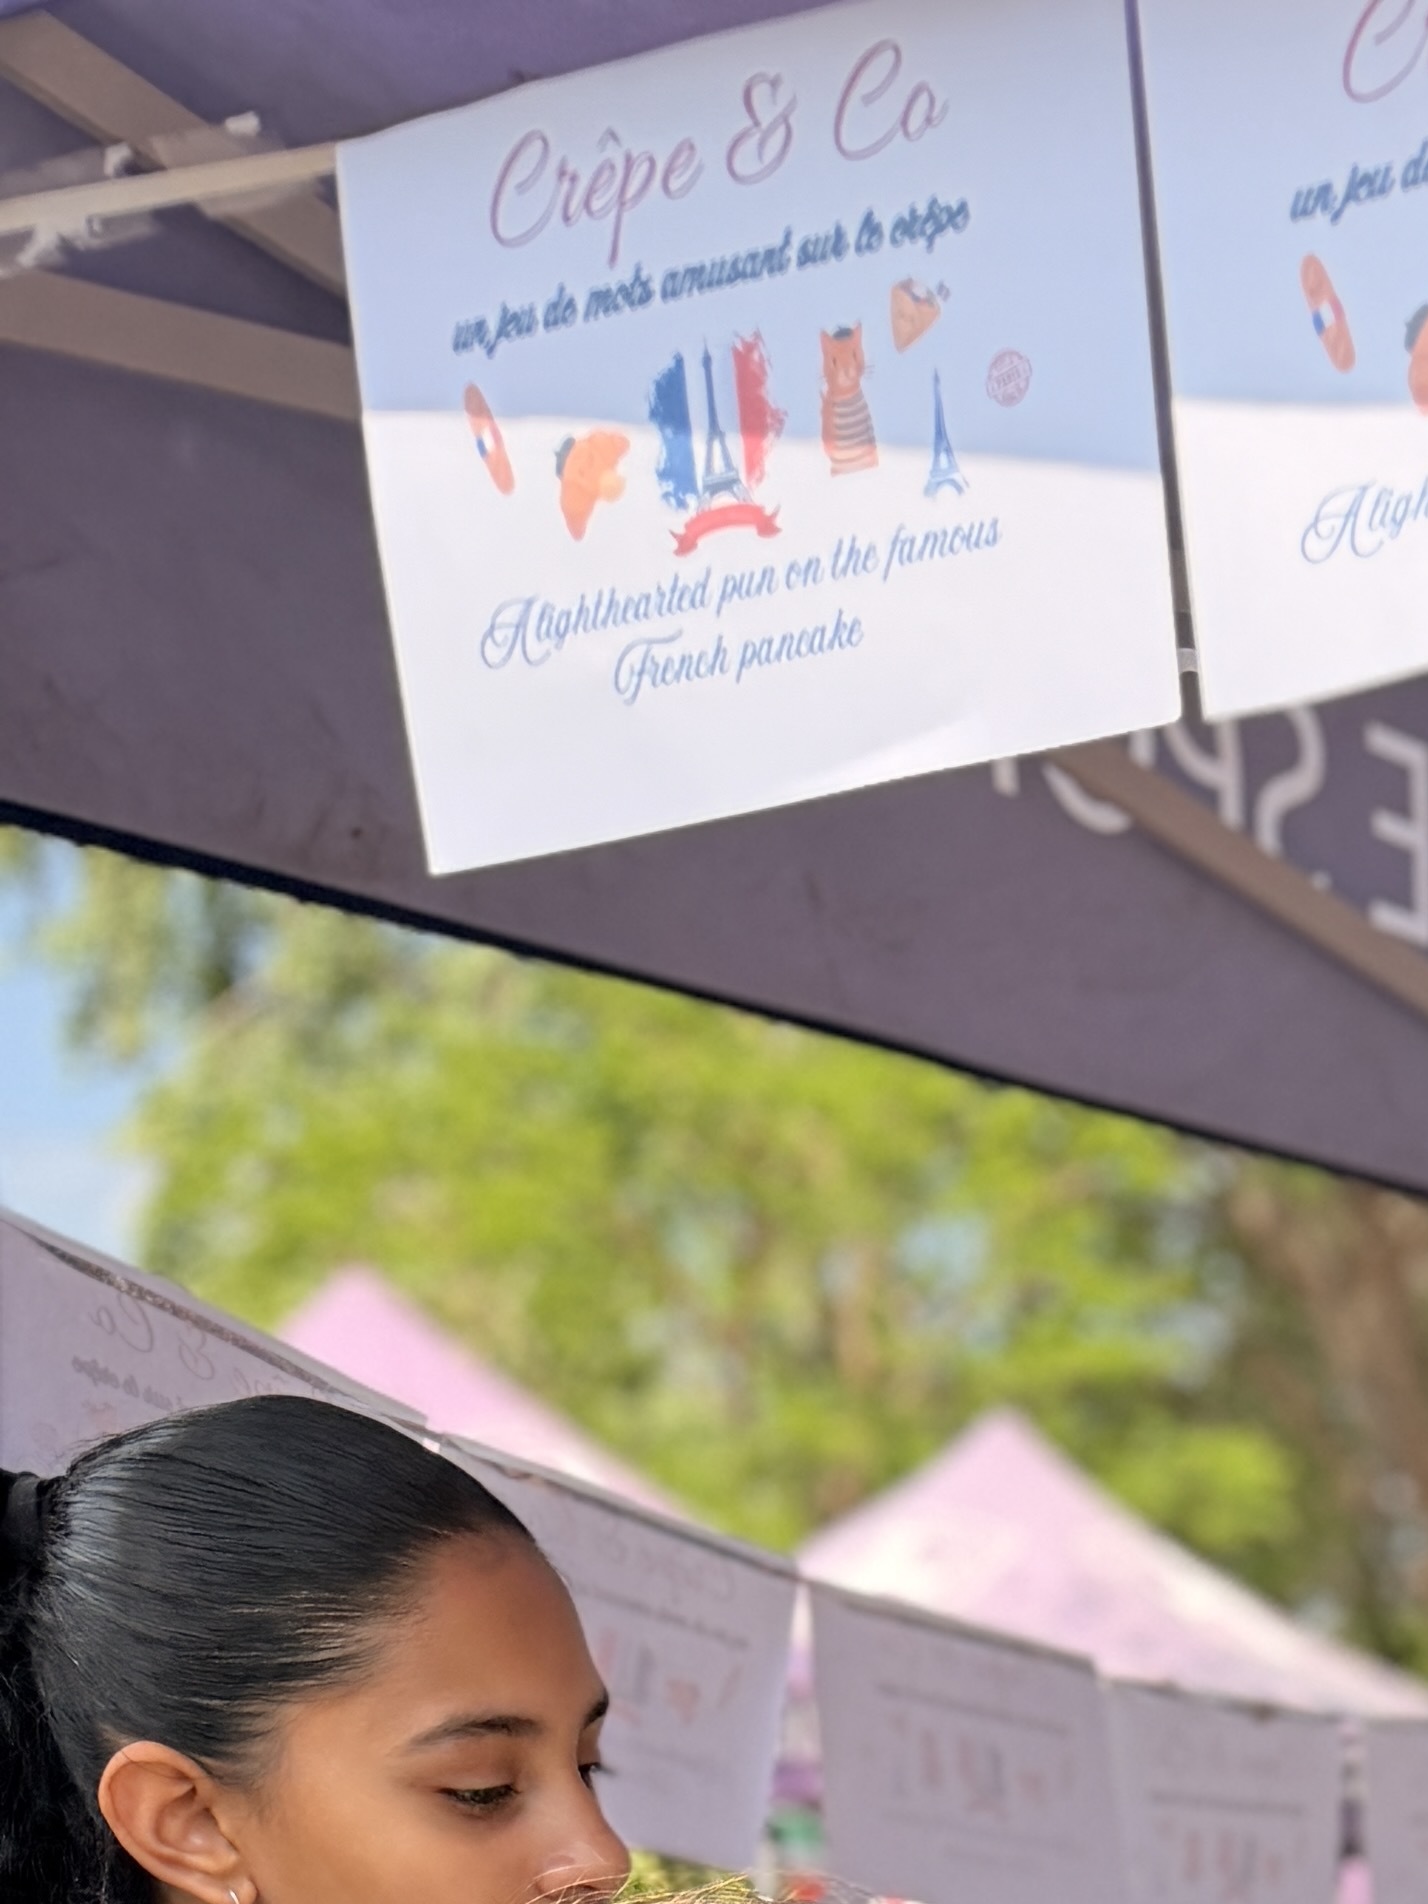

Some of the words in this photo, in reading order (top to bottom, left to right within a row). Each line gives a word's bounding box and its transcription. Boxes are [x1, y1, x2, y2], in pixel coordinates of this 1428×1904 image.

[489, 127, 703, 269] Crêpe
[725, 72, 798, 186] &
[833, 38, 949, 162] Co
[543, 282, 577, 333] de
[584, 262, 655, 324] mots
[661, 225, 794, 303] amusant
[717, 563, 779, 617] pun
[785, 555, 825, 591] on
[831, 534, 879, 580] the
[884, 516, 1003, 582] famous
[614, 629, 731, 706] French
[736, 608, 864, 684] pancake
